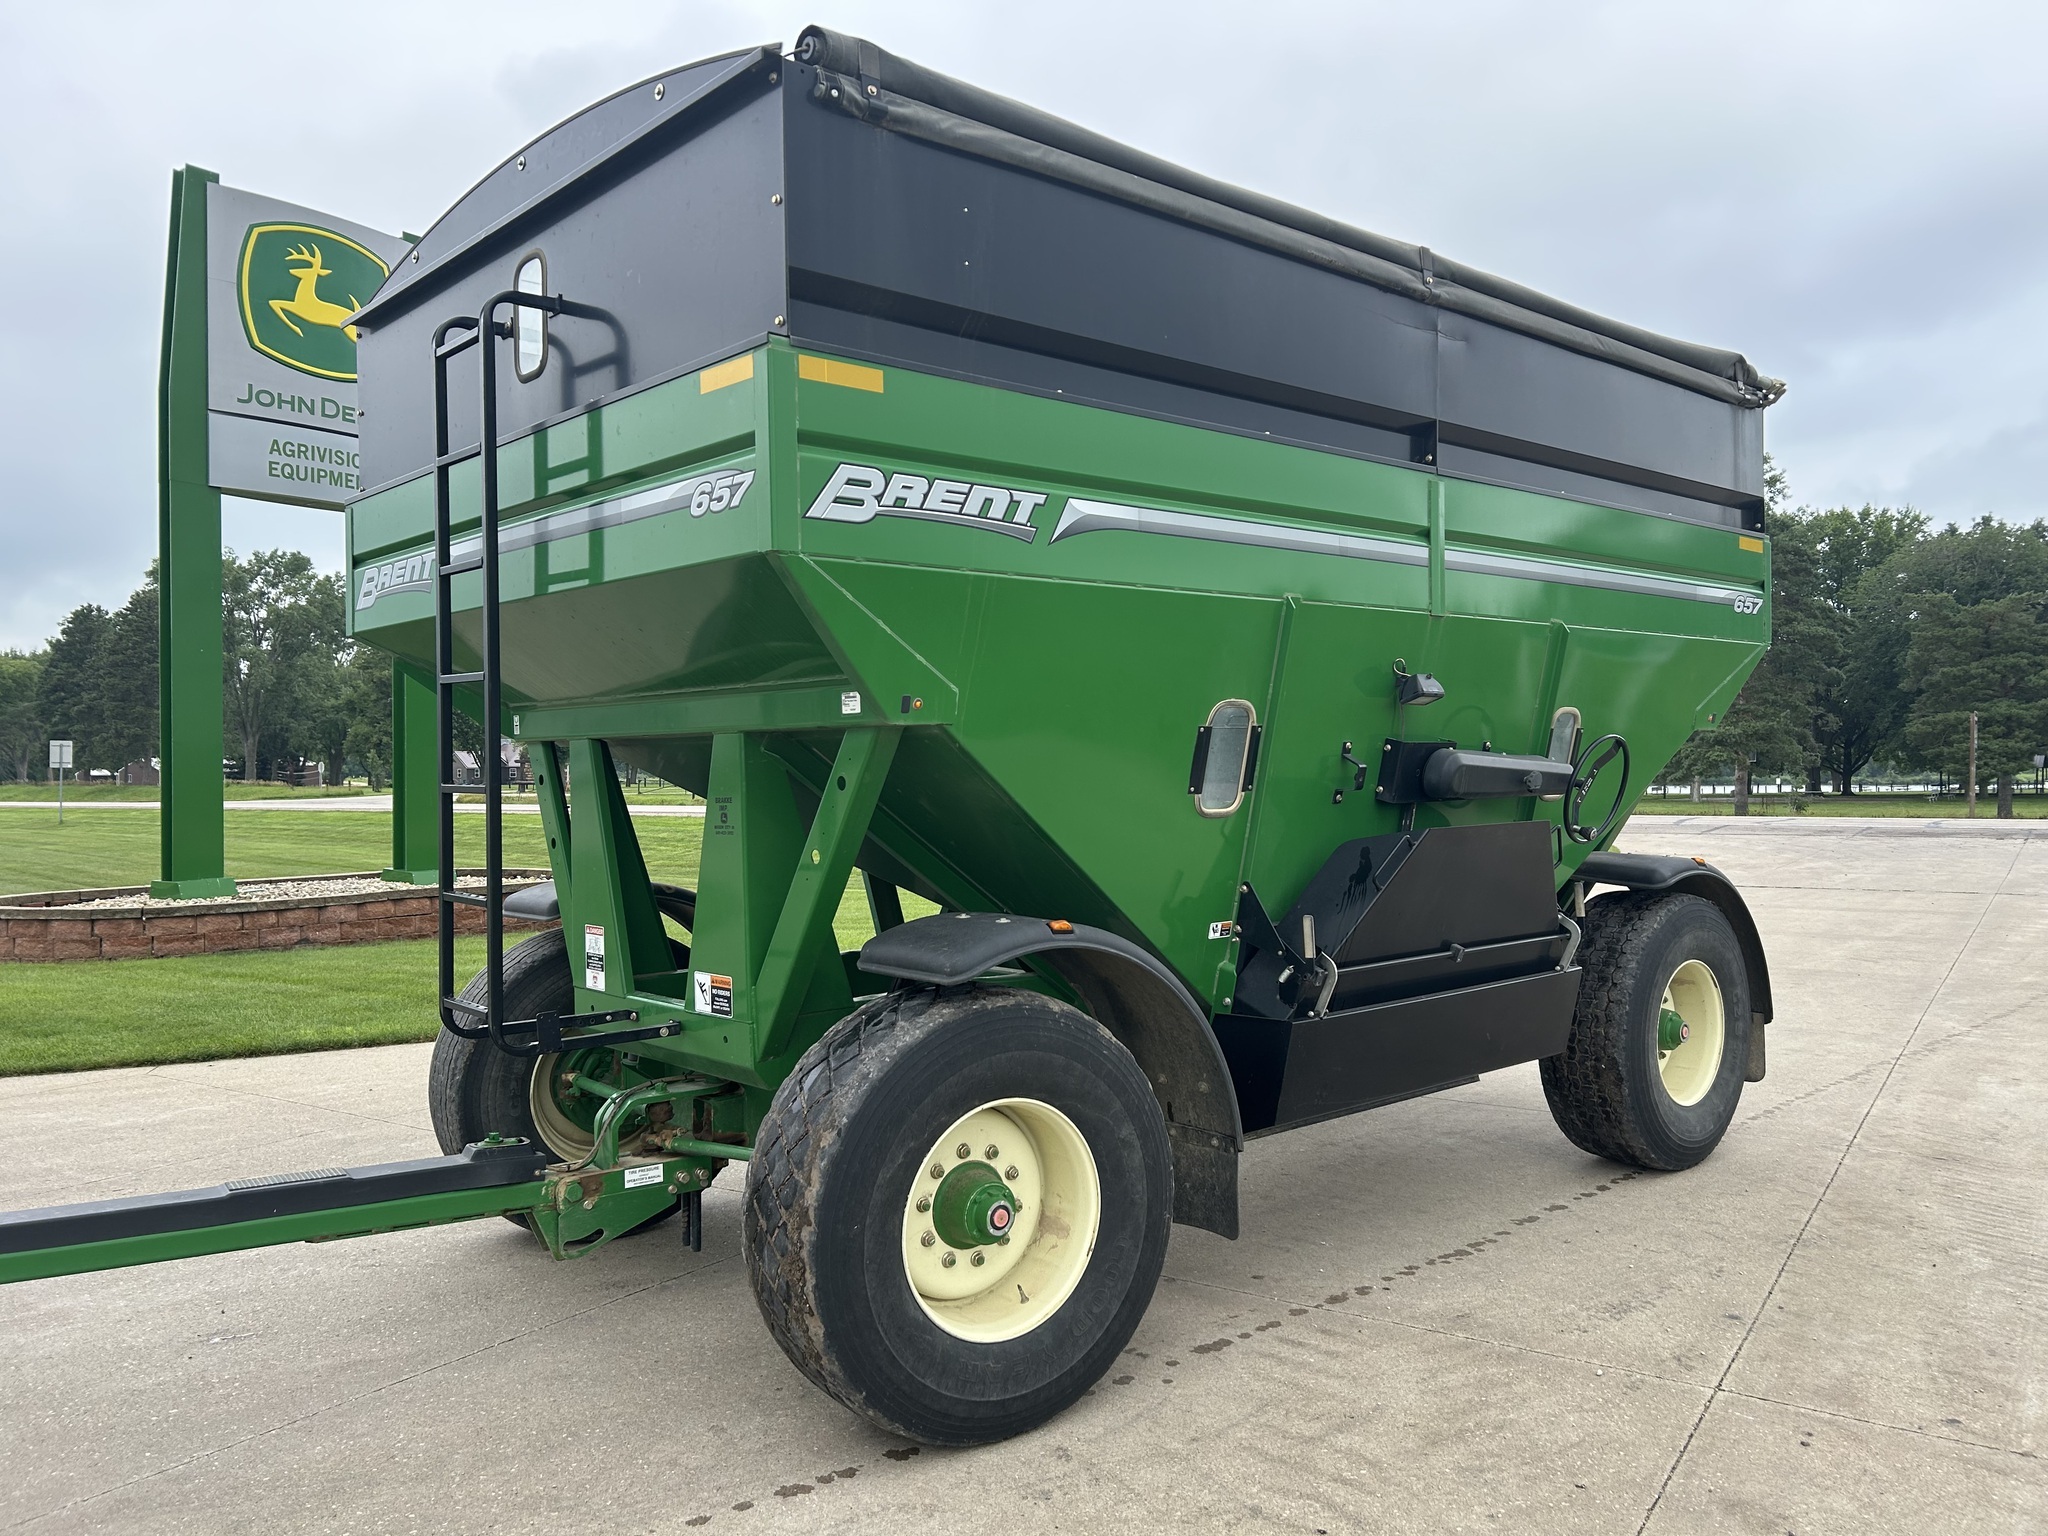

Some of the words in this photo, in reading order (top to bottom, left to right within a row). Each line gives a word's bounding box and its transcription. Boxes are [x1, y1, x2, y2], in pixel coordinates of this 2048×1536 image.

[237, 383, 315, 415] JOHN
[320, 396, 359, 424] DE
[690, 469, 756, 518] 657
[803, 462, 1049, 528] BRENT
[355, 550, 436, 612] BRENT
[1733, 594, 1764, 615] 657
